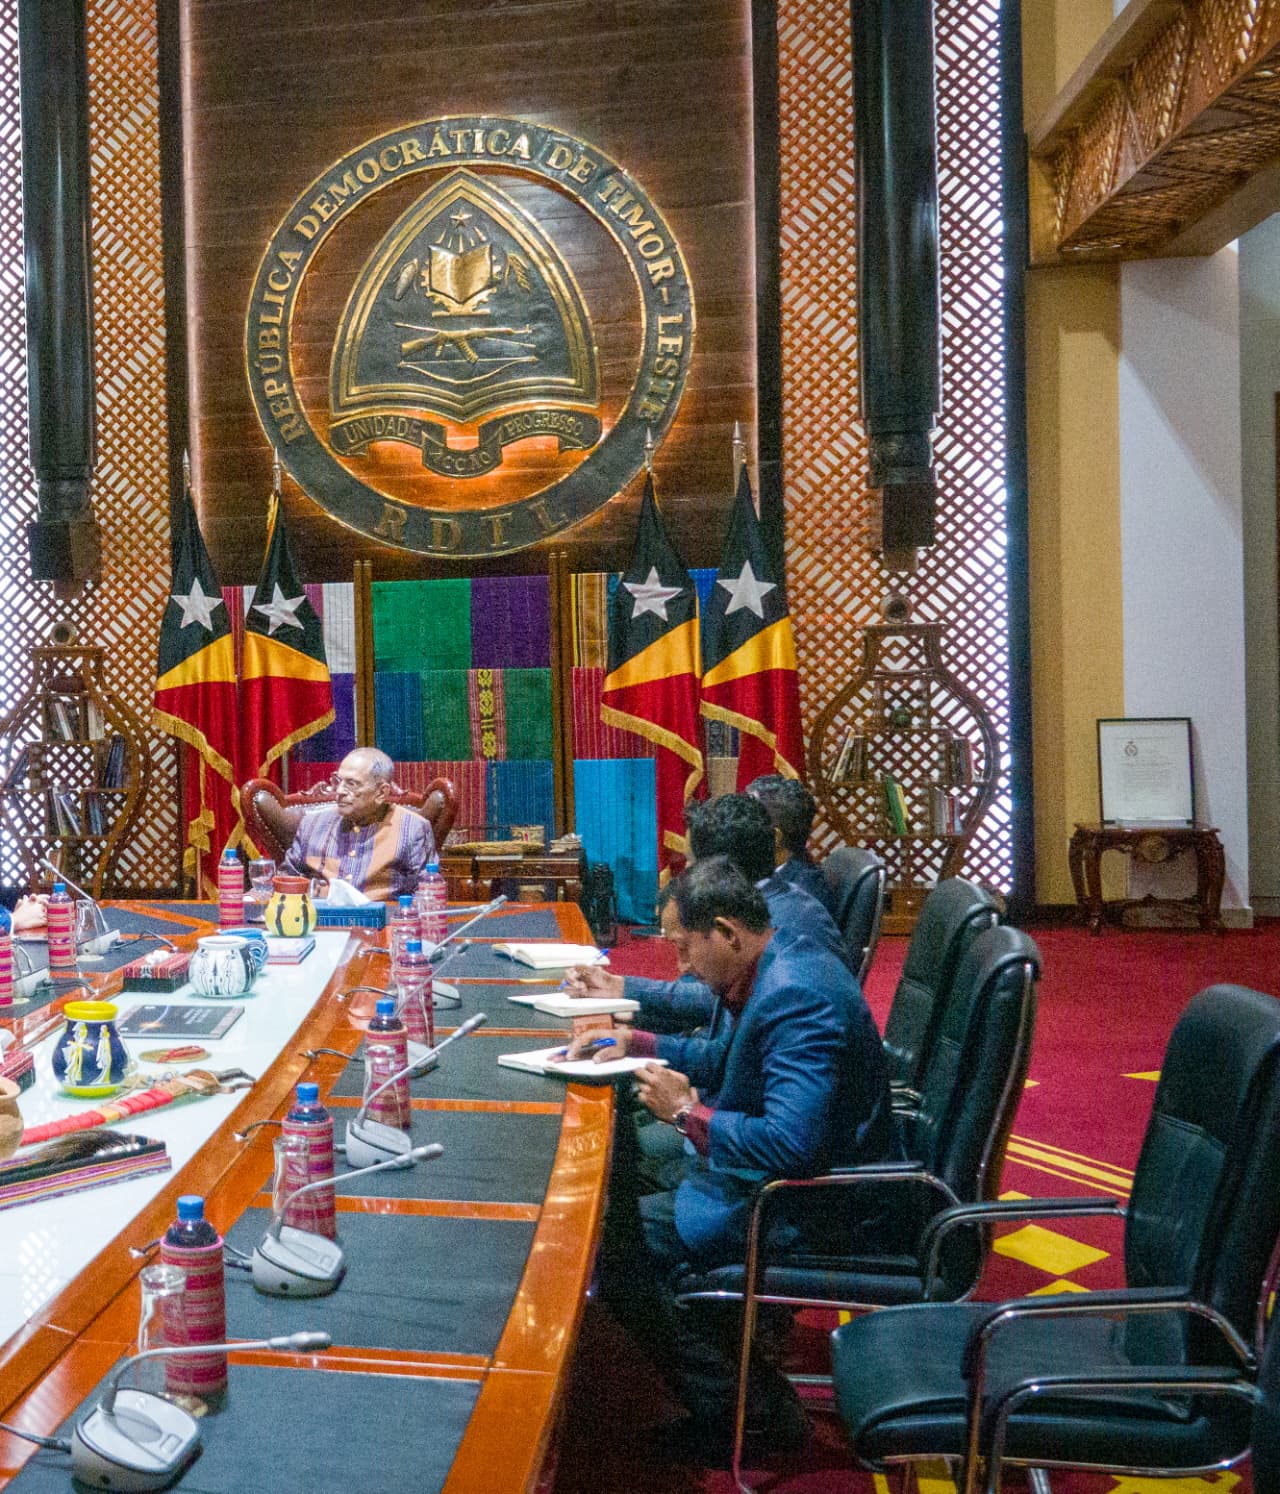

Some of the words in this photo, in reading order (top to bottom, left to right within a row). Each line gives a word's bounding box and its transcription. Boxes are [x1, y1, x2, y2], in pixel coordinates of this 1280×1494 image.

[254, 249, 306, 445] REPÚBLICA
[293, 127, 531, 241] DEMOCRÁTICA
[546, 143, 597, 185] DE
[343, 415, 421, 444] UNIDADE
